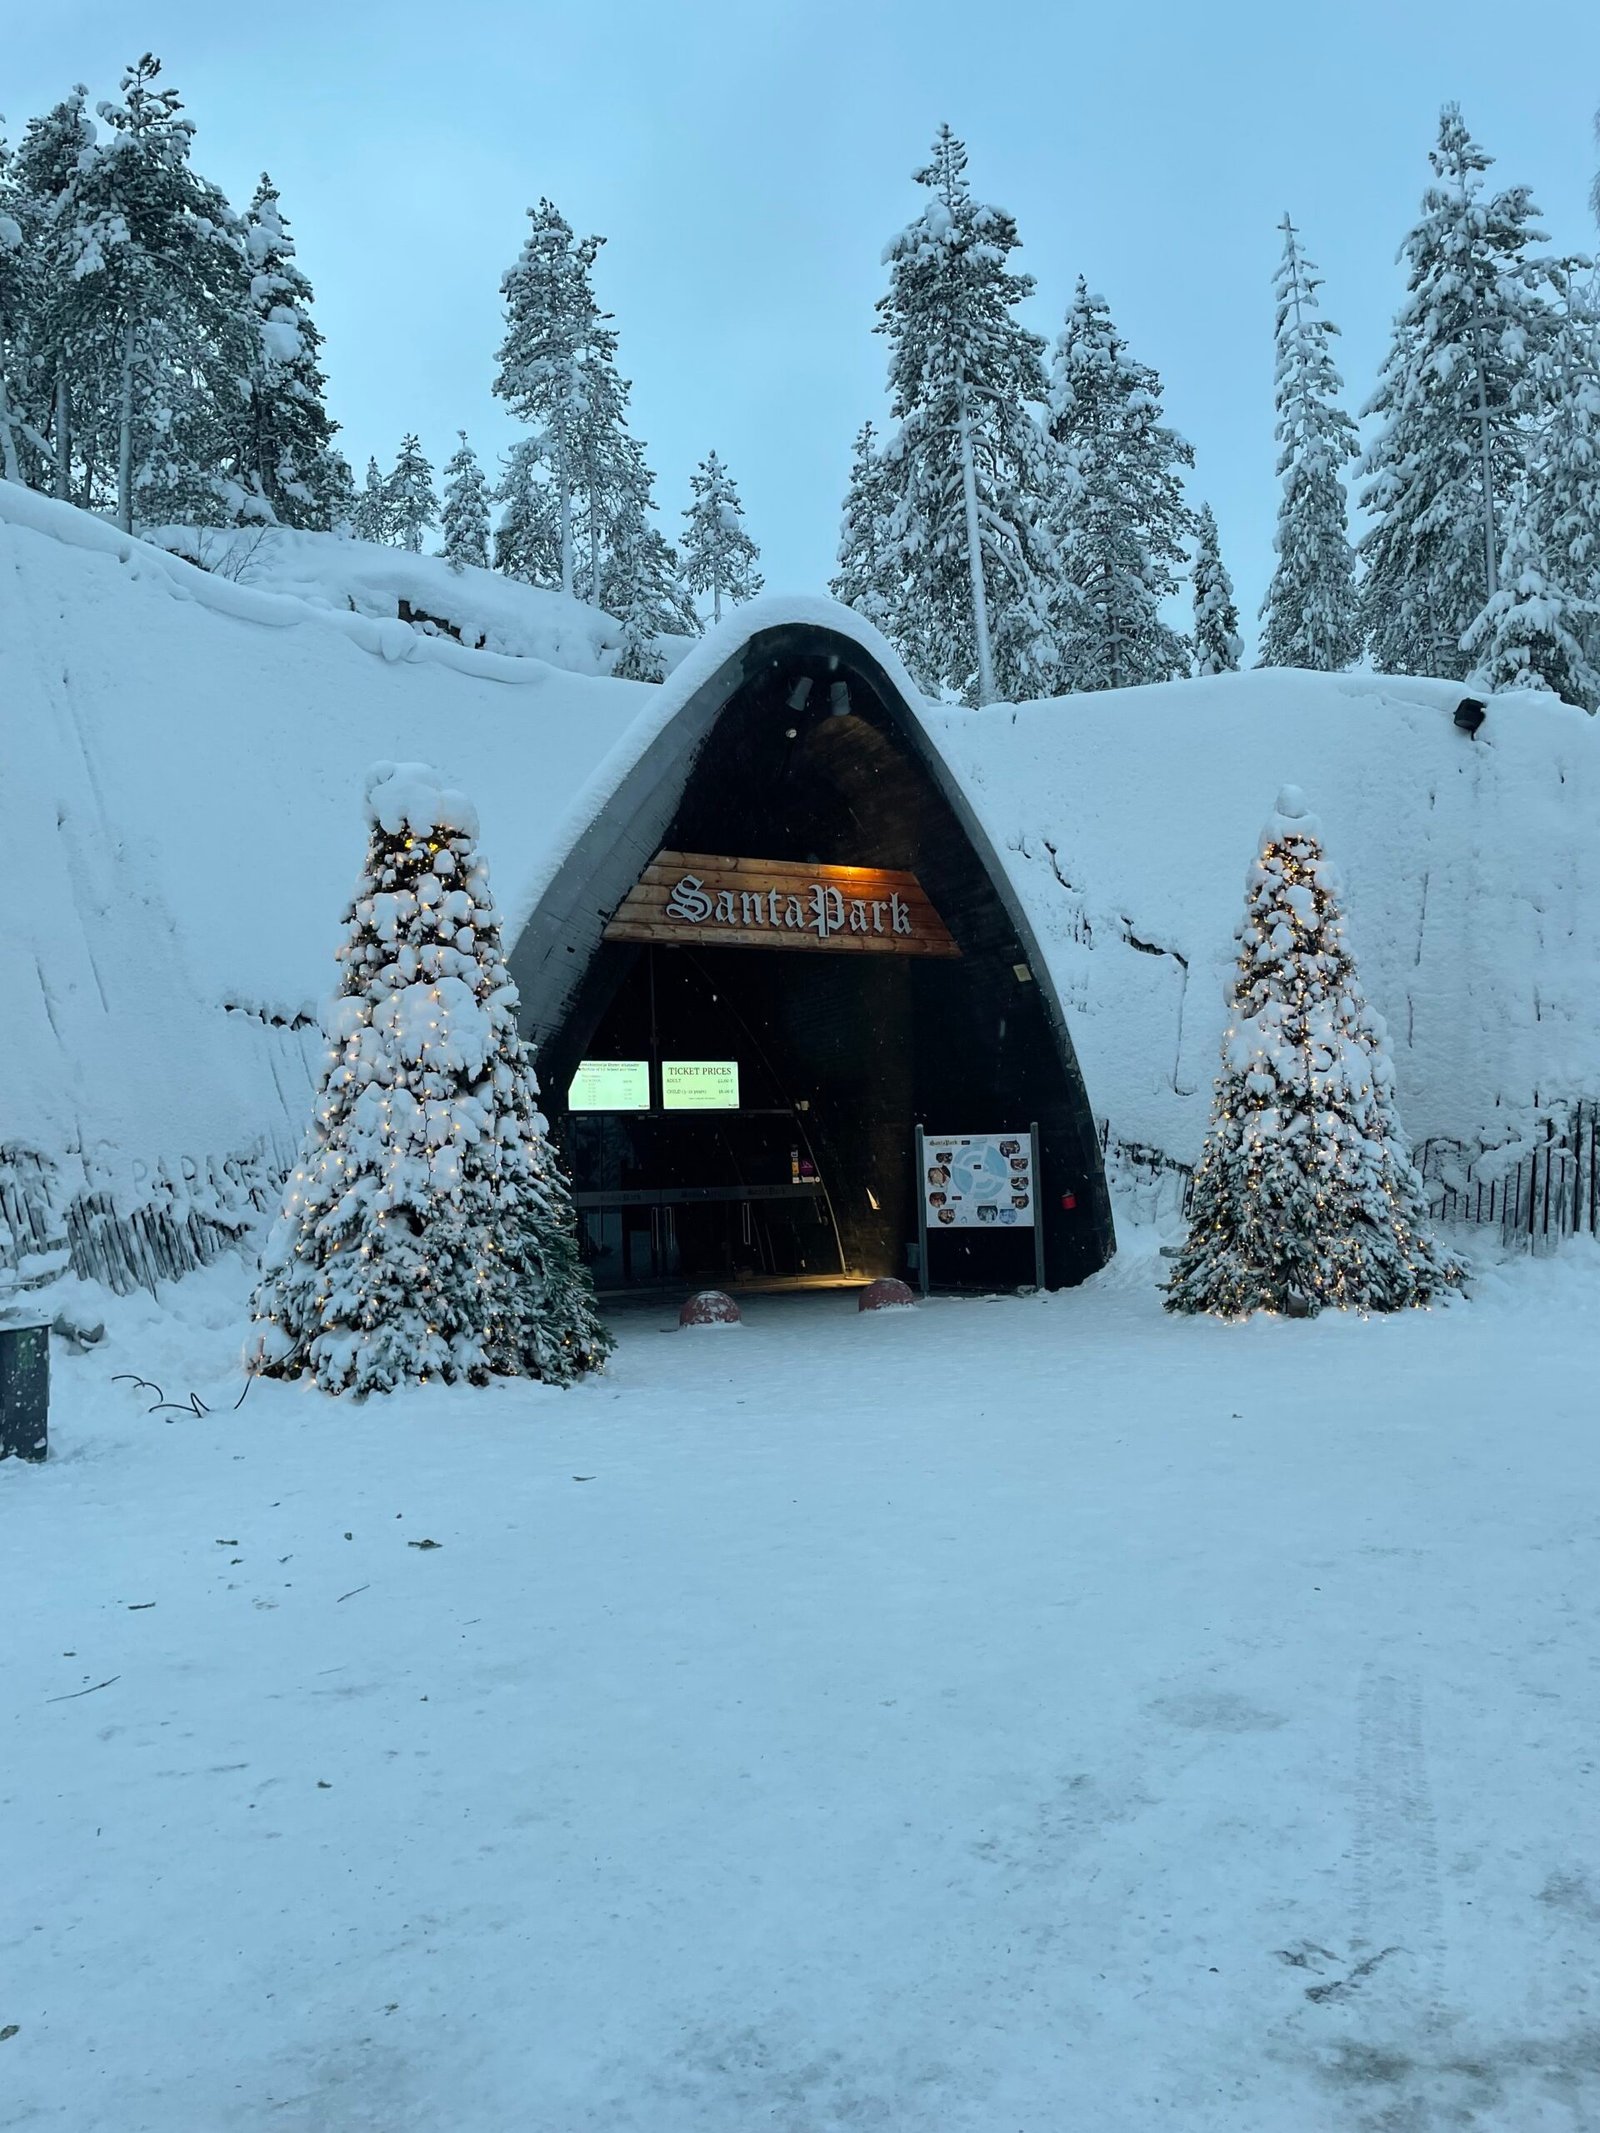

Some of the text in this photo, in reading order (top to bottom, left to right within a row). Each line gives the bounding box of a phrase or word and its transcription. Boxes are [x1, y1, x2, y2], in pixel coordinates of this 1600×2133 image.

[666, 874, 913, 938] SantaPark
[668, 1067, 732, 1076] TICKET PRICES
